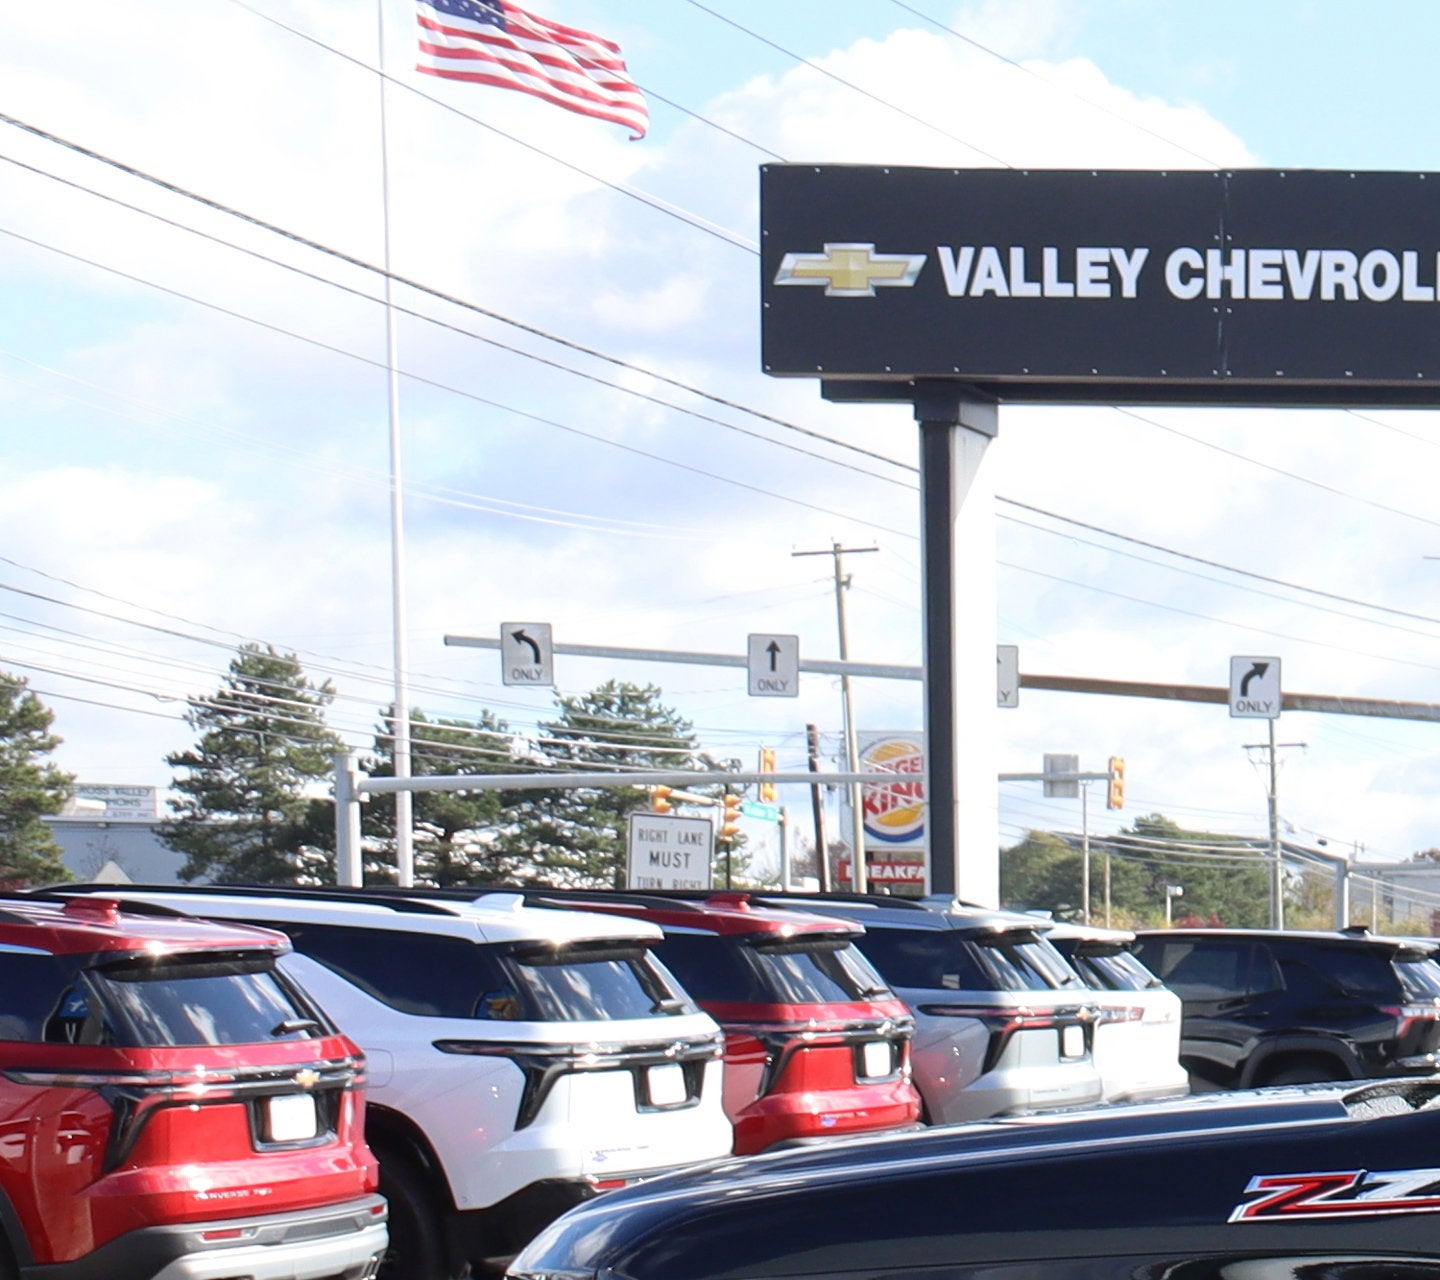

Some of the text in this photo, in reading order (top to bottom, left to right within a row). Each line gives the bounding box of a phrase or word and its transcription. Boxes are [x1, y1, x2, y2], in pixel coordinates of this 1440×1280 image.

[936, 245, 1150, 299] VALLEY
[511, 668, 544, 681] ONLY
[756, 679, 788, 692] ONLY
[1236, 700, 1273, 713] ONLY
[638, 828, 704, 846] RIGHT LANE
[648, 850, 691, 868] MUST
[637, 876, 703, 889] TURN RIGHT
